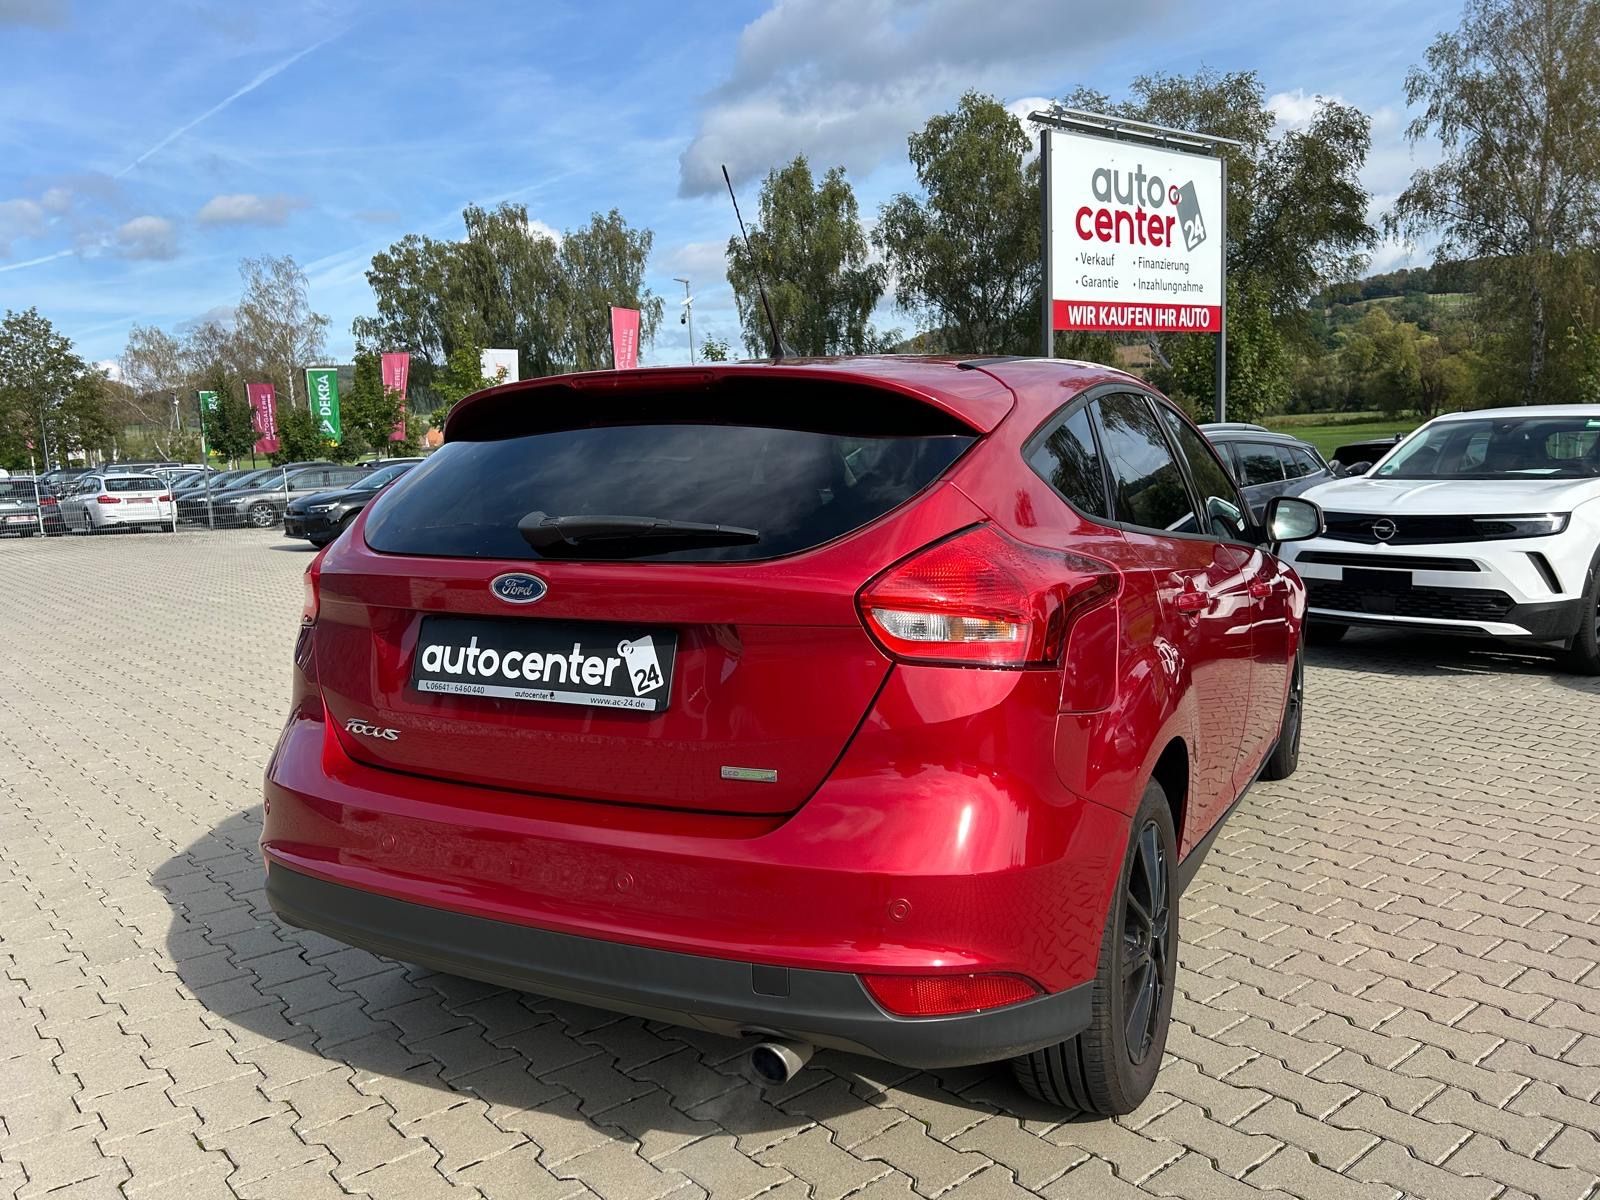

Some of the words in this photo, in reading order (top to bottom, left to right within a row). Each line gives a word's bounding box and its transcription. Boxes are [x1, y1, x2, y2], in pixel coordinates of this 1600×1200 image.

[1092, 163, 1166, 209] auto
[1075, 206, 1176, 247] center
[1184, 213, 1205, 249] 24
[1081, 252, 1115, 267] Verkauf
[1138, 256, 1190, 274] Finanzierung
[1081, 275, 1119, 289] Garantie
[1138, 278, 1204, 294] Inzahlungnahme
[1068, 305, 1096, 325] WIR
[1099, 306, 1153, 327] KAUFEN
[1155, 308, 1177, 327] IHR
[1179, 308, 1210, 328] AUTO
[317, 374, 332, 416] DEKRA
[501, 578, 533, 596] Ford
[430, 682, 450, 691] 06641
[634, 663, 660, 692] 24
[590, 697, 646, 708] www.ac-24.de
